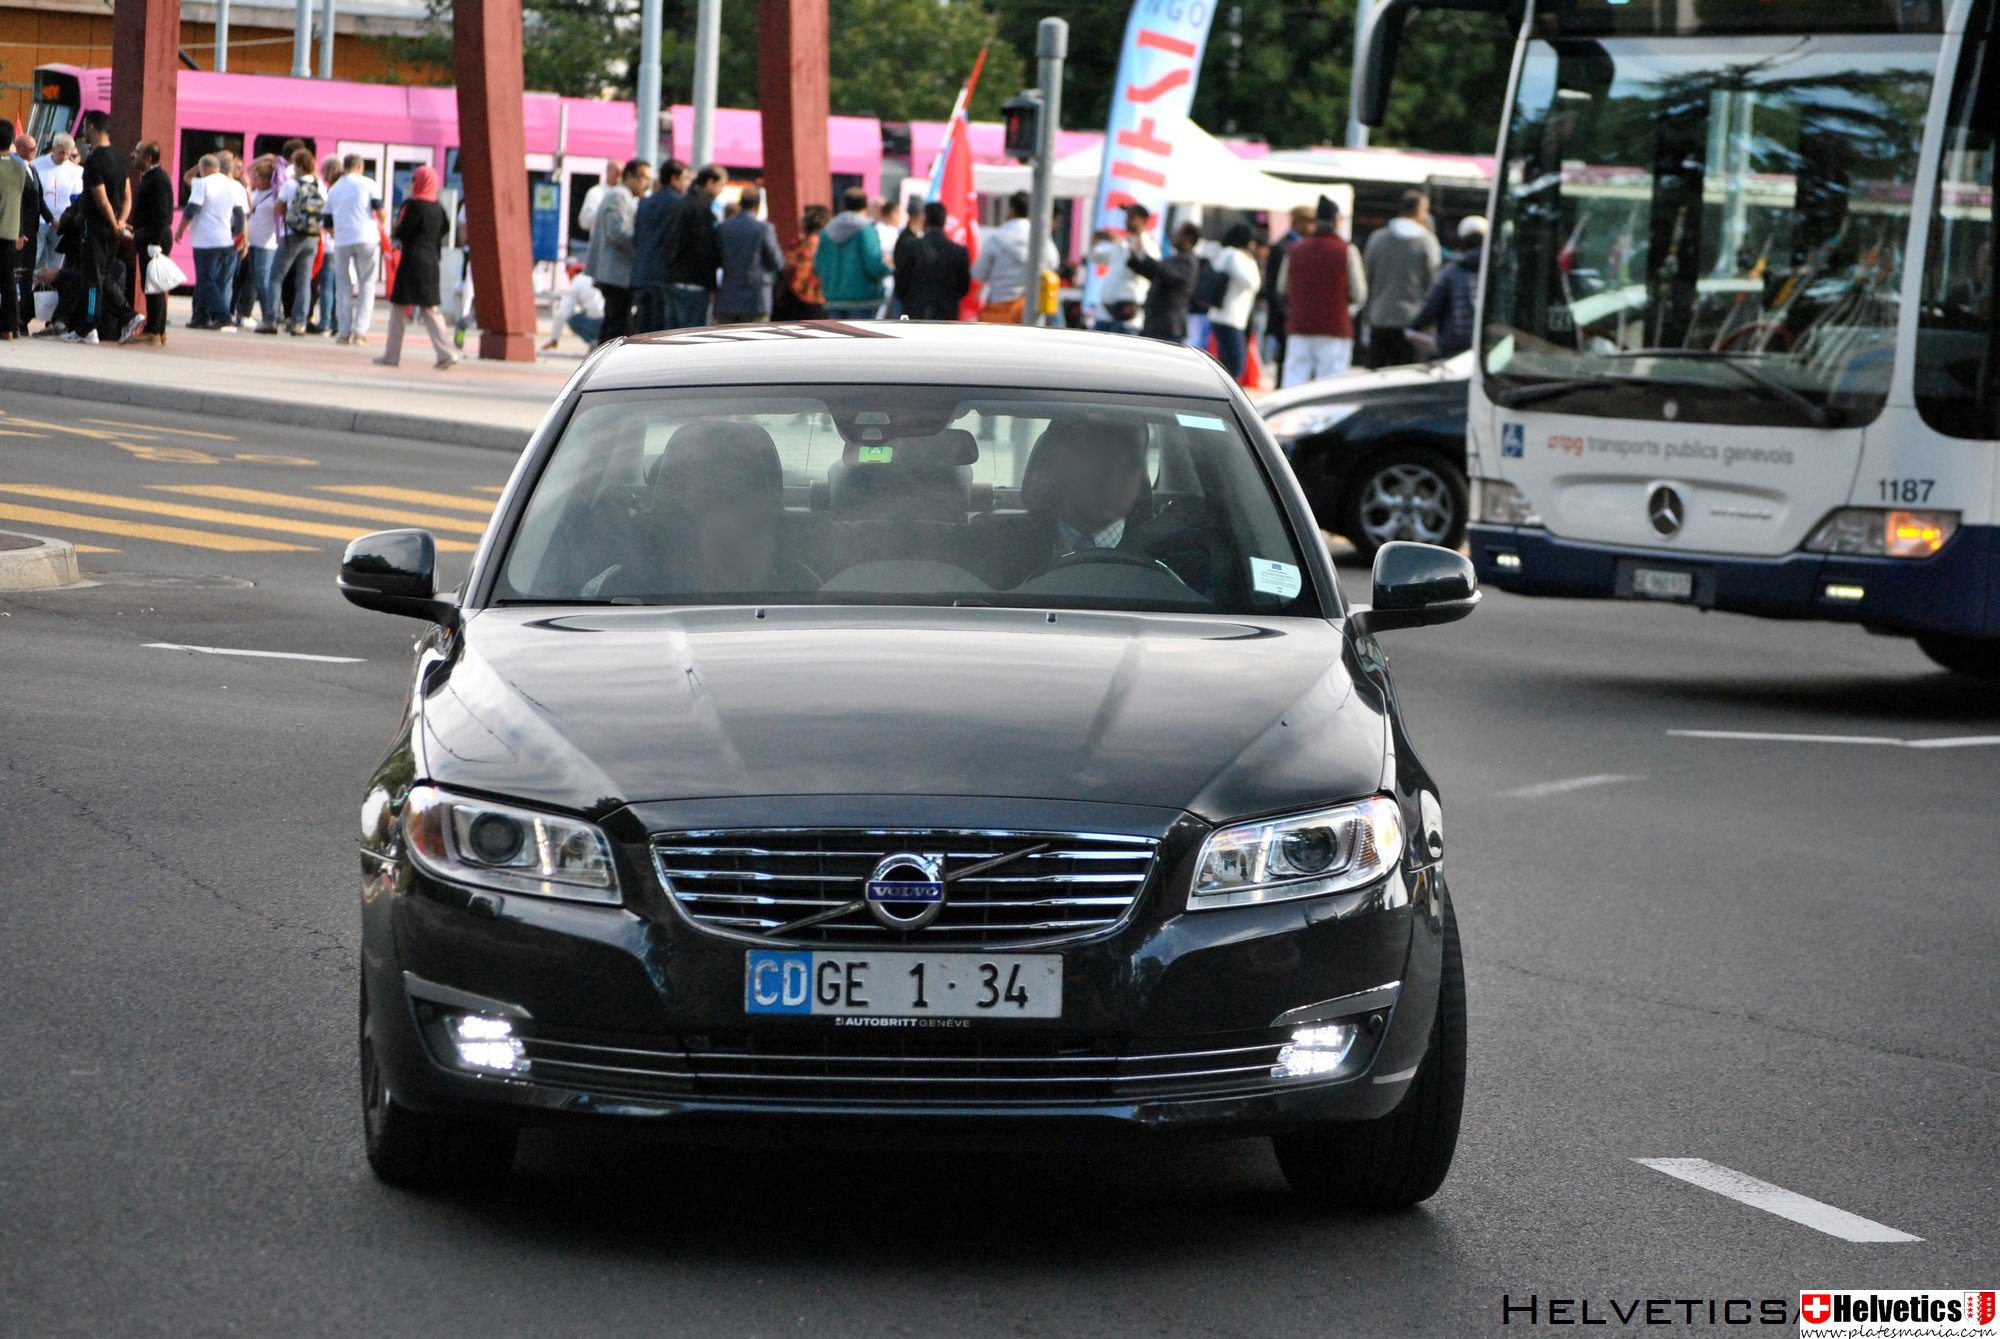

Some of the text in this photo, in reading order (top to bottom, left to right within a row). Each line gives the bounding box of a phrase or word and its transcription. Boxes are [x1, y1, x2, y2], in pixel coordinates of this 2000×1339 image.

[1587, 436, 1660, 458] transports
[1664, 440, 1718, 461] publics
[1723, 445, 1793, 466] genevois
[1878, 478, 1935, 503] 1187
[873, 886, 938, 897] VOLVO
[753, 959, 808, 1008] CD
[816, 960, 870, 1008] GE
[845, 1017, 918, 1027] AUTOBRITT
